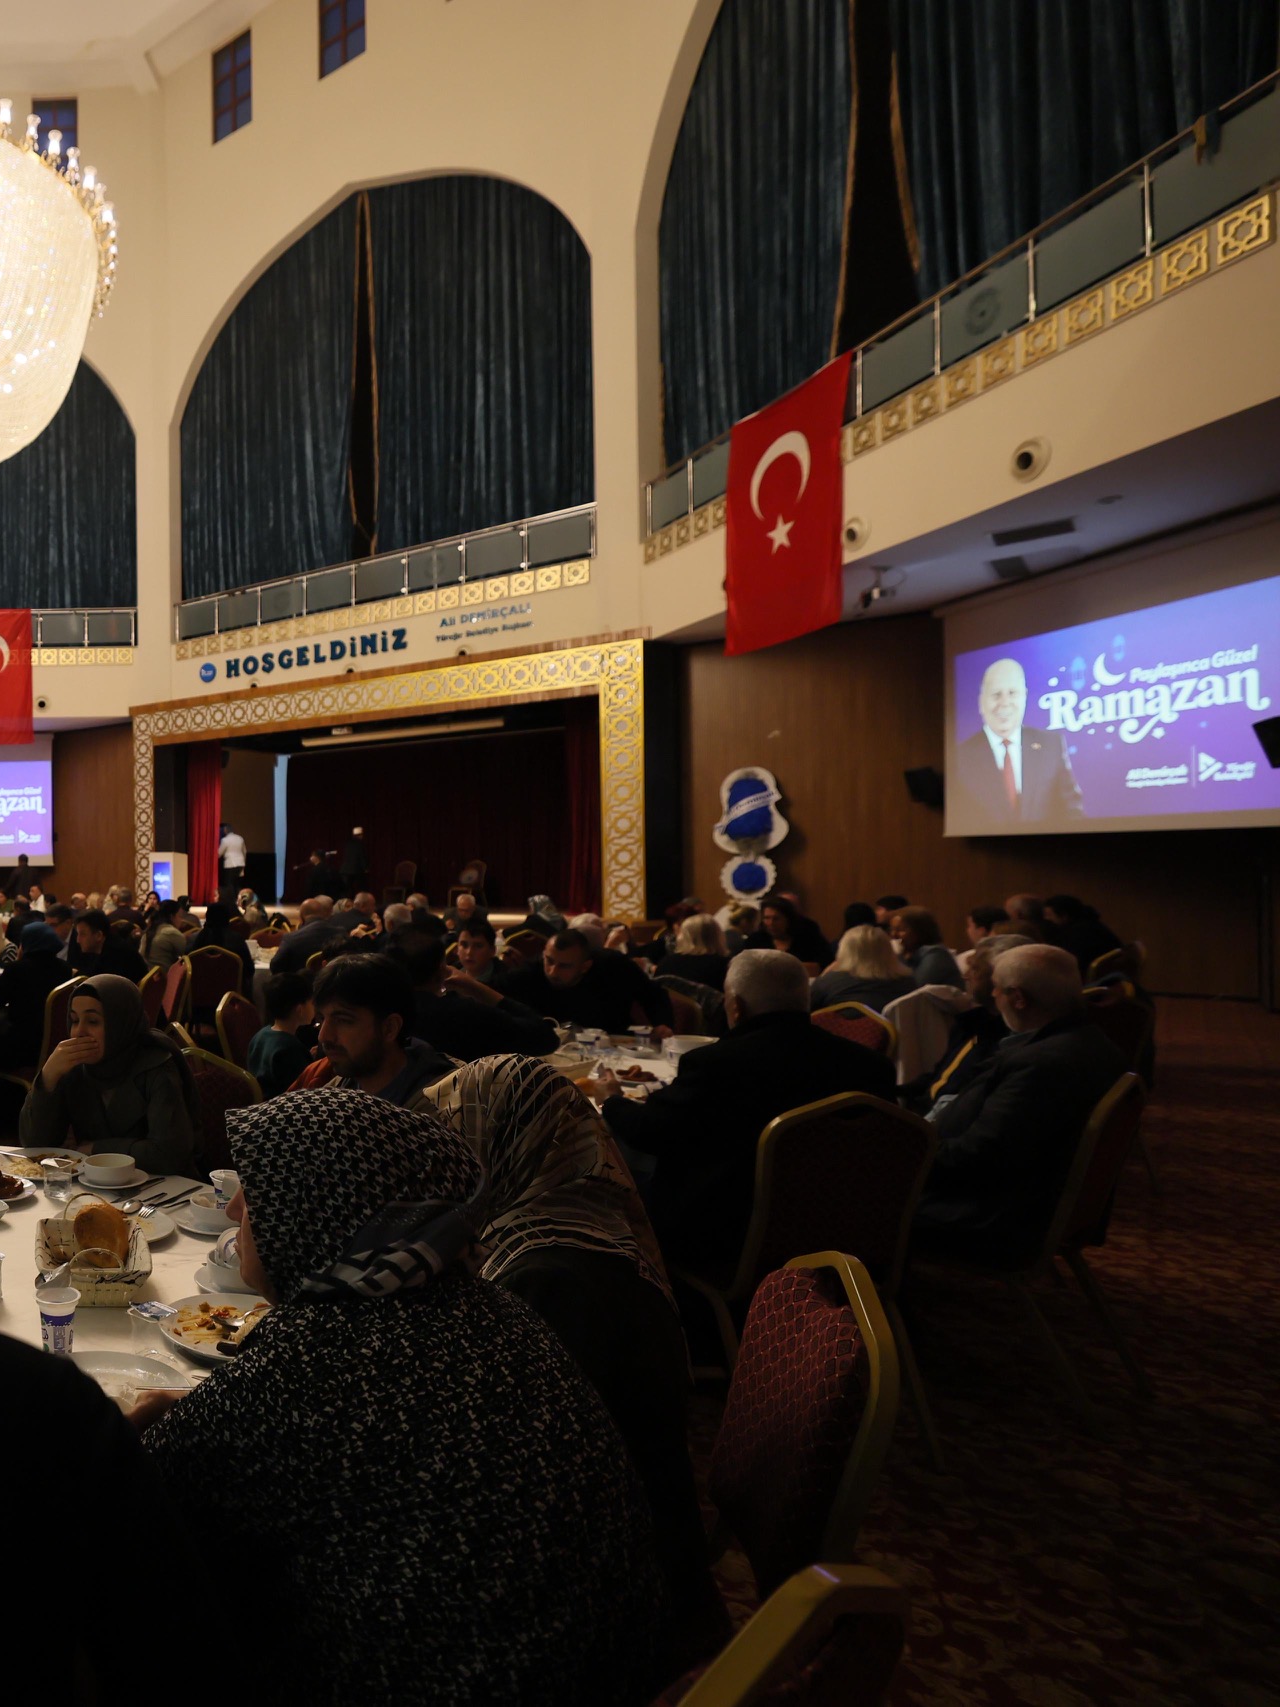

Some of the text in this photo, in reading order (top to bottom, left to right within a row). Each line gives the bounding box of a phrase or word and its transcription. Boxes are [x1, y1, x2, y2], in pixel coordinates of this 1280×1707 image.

[440, 616, 456, 628] Ali
[1212, 643, 1258, 669] Güzel
[1038, 667, 1271, 744] Ramazan
